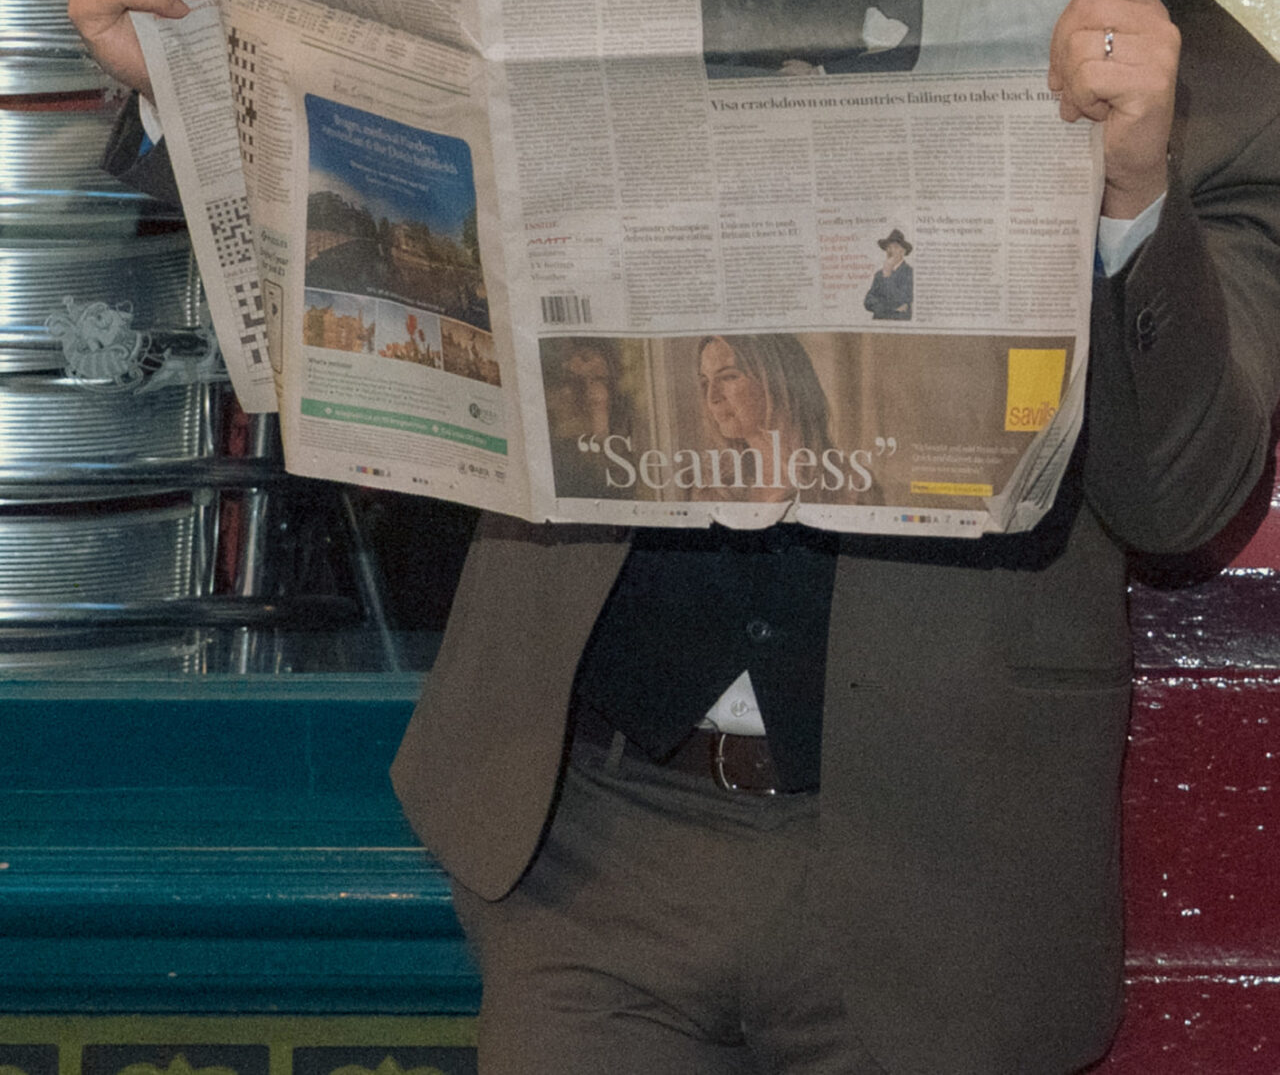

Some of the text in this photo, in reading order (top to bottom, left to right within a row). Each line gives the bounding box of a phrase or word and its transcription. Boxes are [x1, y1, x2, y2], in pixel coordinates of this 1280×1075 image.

[710, 99, 739, 111] Visa
[741, 97, 817, 110] crackdown
[819, 98, 837, 108] on
[838, 94, 904, 108] countries
[953, 92, 967, 103] to
[969, 90, 999, 103] take
[1001, 88, 1035, 101] back
[577, 429, 898, 493] “Seamless”
